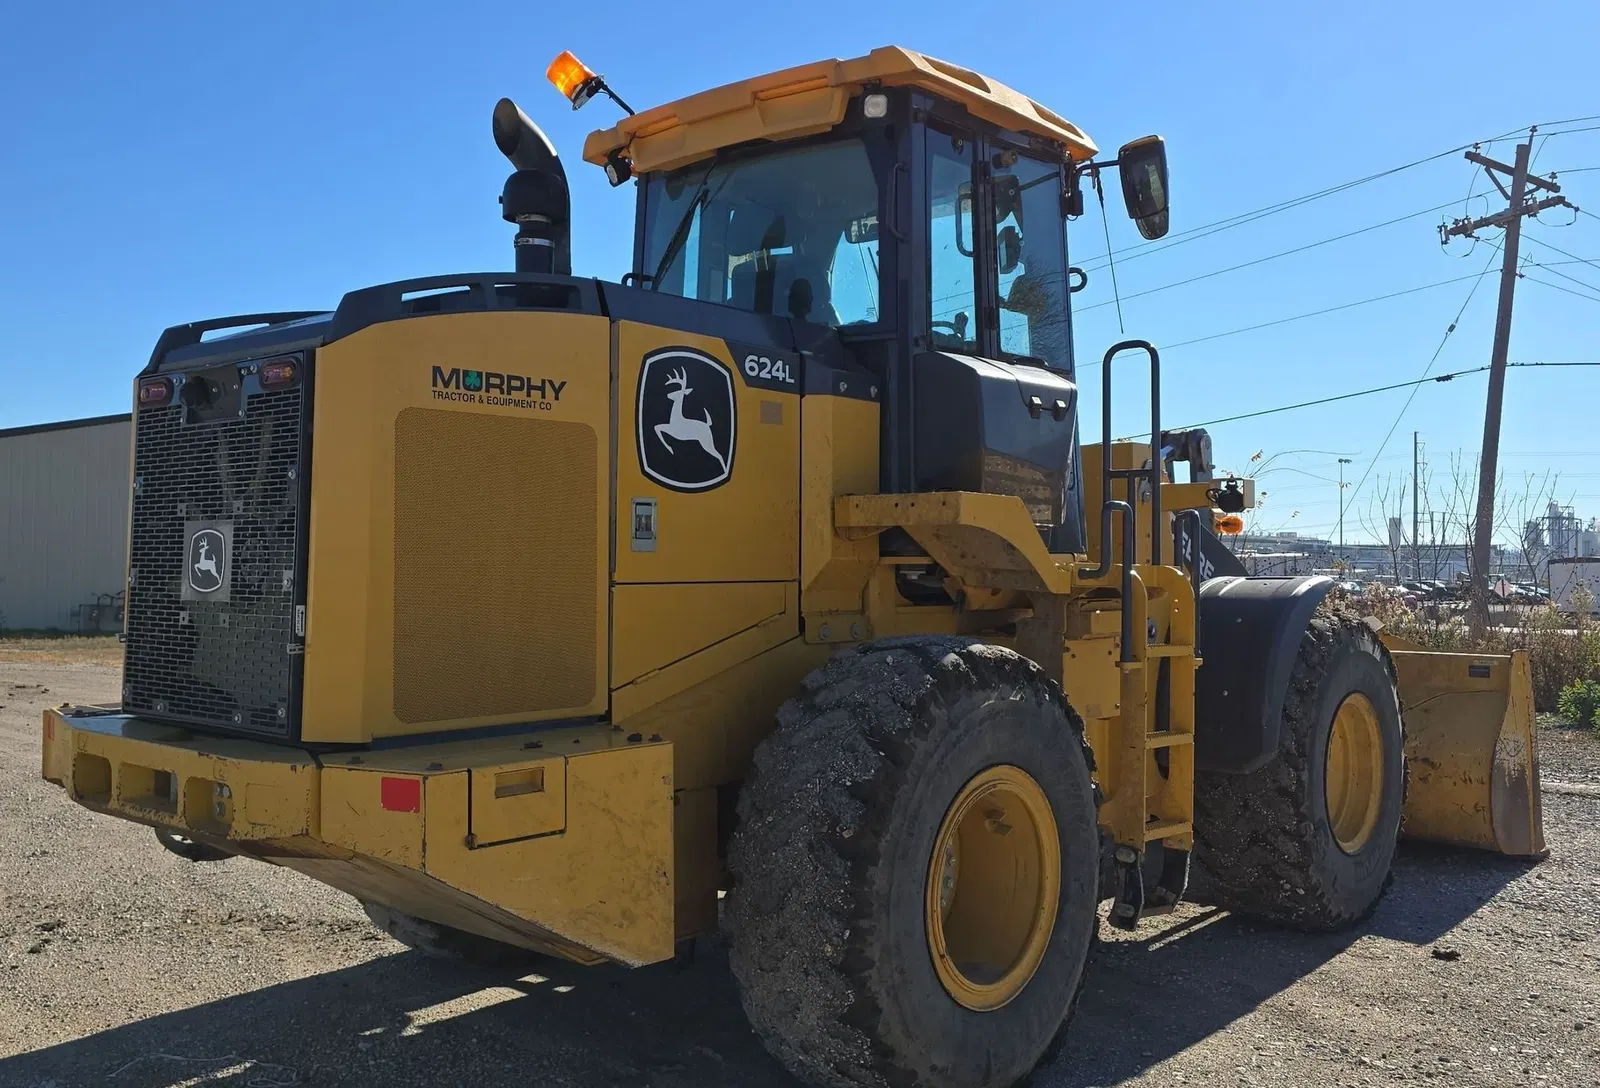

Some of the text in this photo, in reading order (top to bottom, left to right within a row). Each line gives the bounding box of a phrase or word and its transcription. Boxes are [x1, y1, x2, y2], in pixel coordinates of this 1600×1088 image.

[432, 365, 567, 401] MURPHY
[744, 354, 795, 384] 624L
[432, 390, 552, 411] TRACTOR & EQUIPMENT CO
